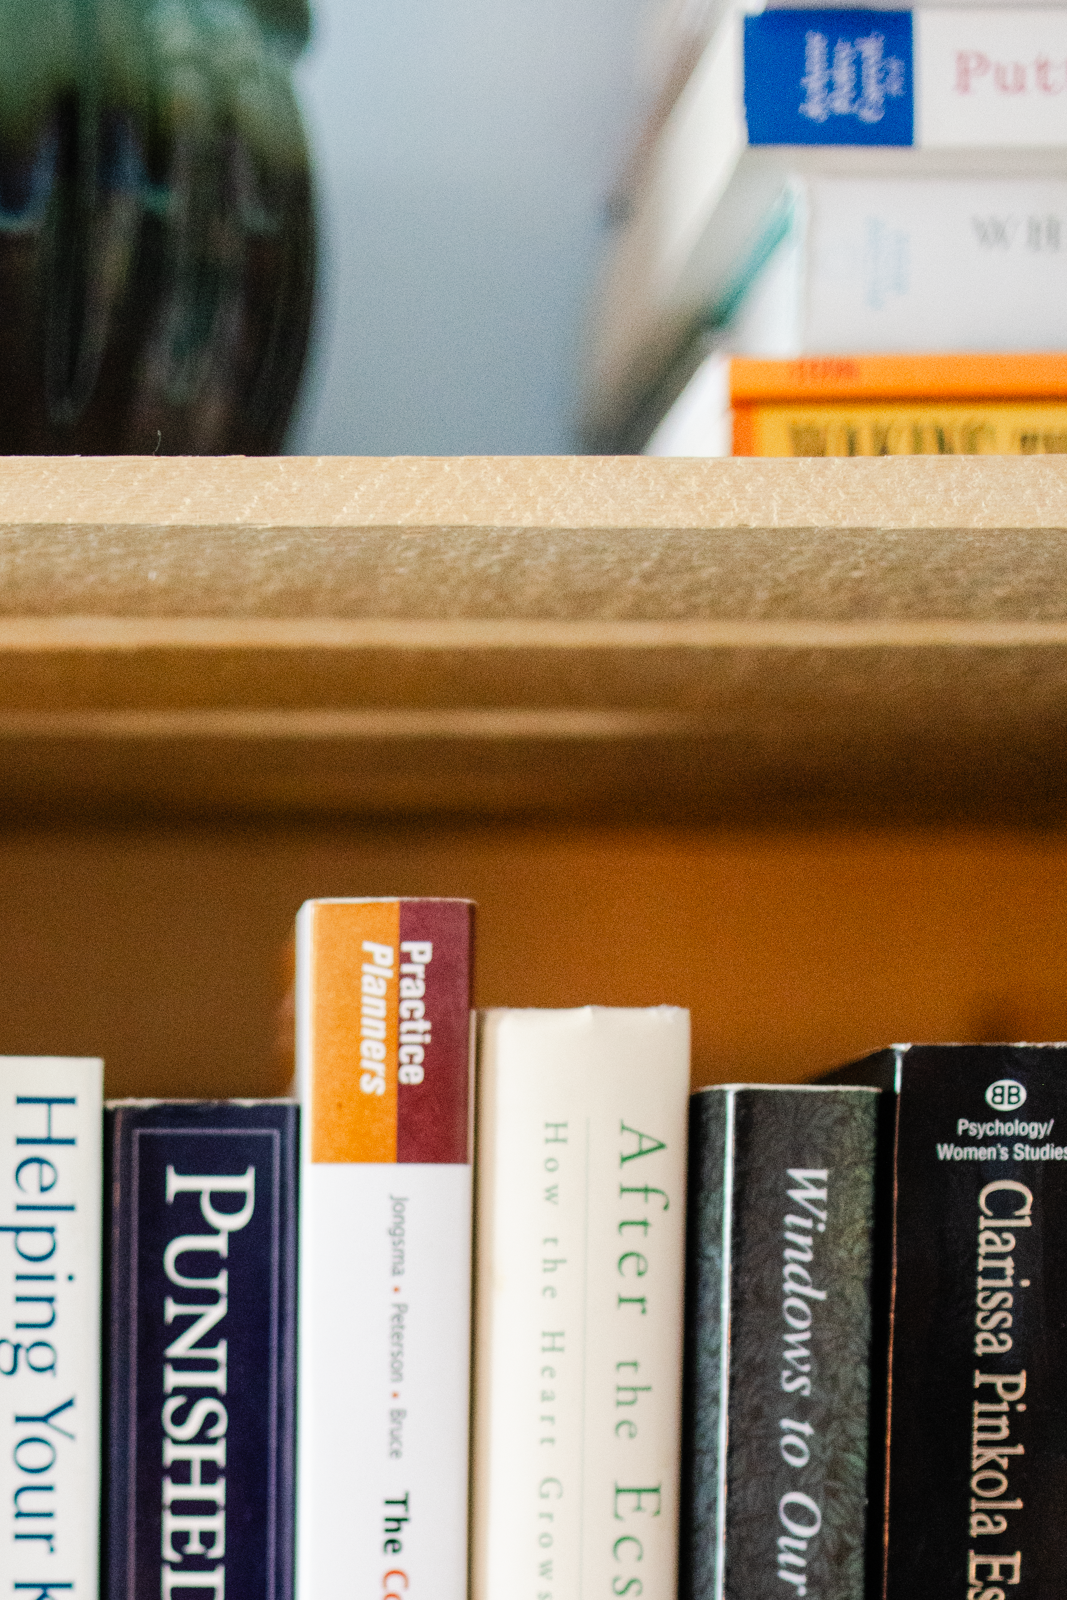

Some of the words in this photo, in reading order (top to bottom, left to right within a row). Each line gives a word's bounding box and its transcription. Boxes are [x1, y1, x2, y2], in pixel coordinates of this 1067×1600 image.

[954, 48, 1067, 96] Put
[359, 940, 394, 1096] Planners
[398, 941, 433, 1086] Practice
[544, 1121, 568, 1205] How
[957, 1118, 1054, 1140] Psychology/
[388, 1194, 408, 1277] Jongsma
[618, 1119, 670, 1316] After
[542, 1237, 567, 1299] the
[782, 1168, 828, 1397] Windows
[974, 1179, 1033, 1357] Clarissa
[390, 1303, 408, 1383] Peterson
[539, 1330, 565, 1445] Heart
[614, 1360, 652, 1439] the
[13, 1398, 75, 1554] Your
[389, 1408, 407, 1460] Bruce
[780, 1418, 815, 1467] to
[969, 1369, 1027, 1538] Pinkola
[383, 1491, 409, 1555] The
[777, 1491, 822, 1597] Our
